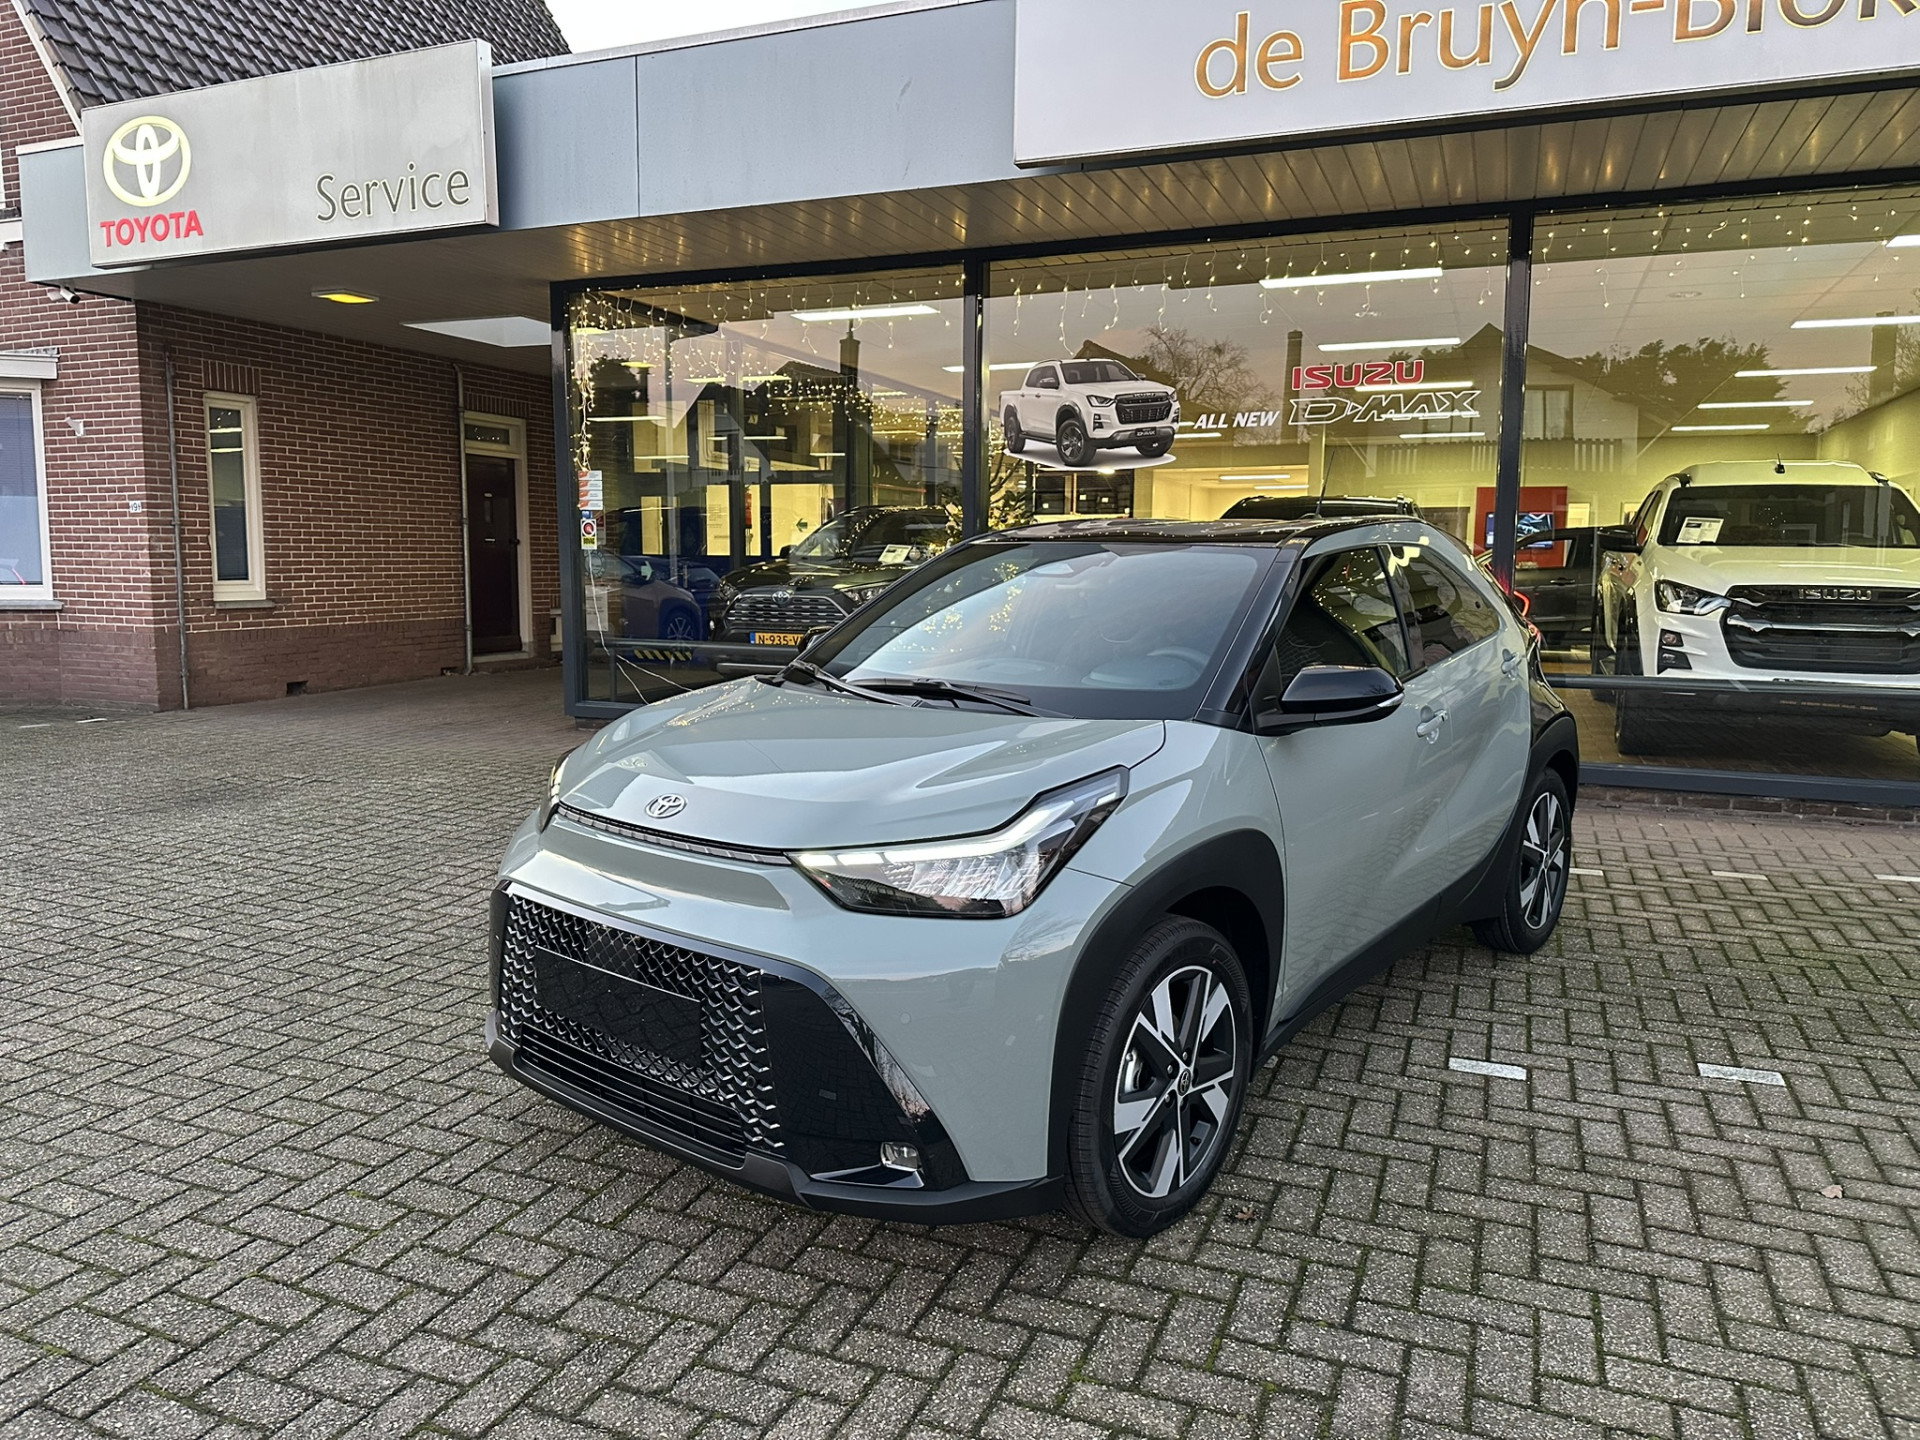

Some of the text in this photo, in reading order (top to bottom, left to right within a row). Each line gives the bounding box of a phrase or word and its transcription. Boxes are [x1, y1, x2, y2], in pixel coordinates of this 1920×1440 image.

[1195, 0, 1919, 98] de Bruyn-
[315, 162, 471, 221] Service
[100, 209, 204, 247] TOYOTA
[1292, 360, 1424, 390] ISUZU
[1193, 410, 1281, 430] ALL NEW
[1798, 589, 1872, 601] ISUZU
[758, 635, 803, 646] N-935-V
